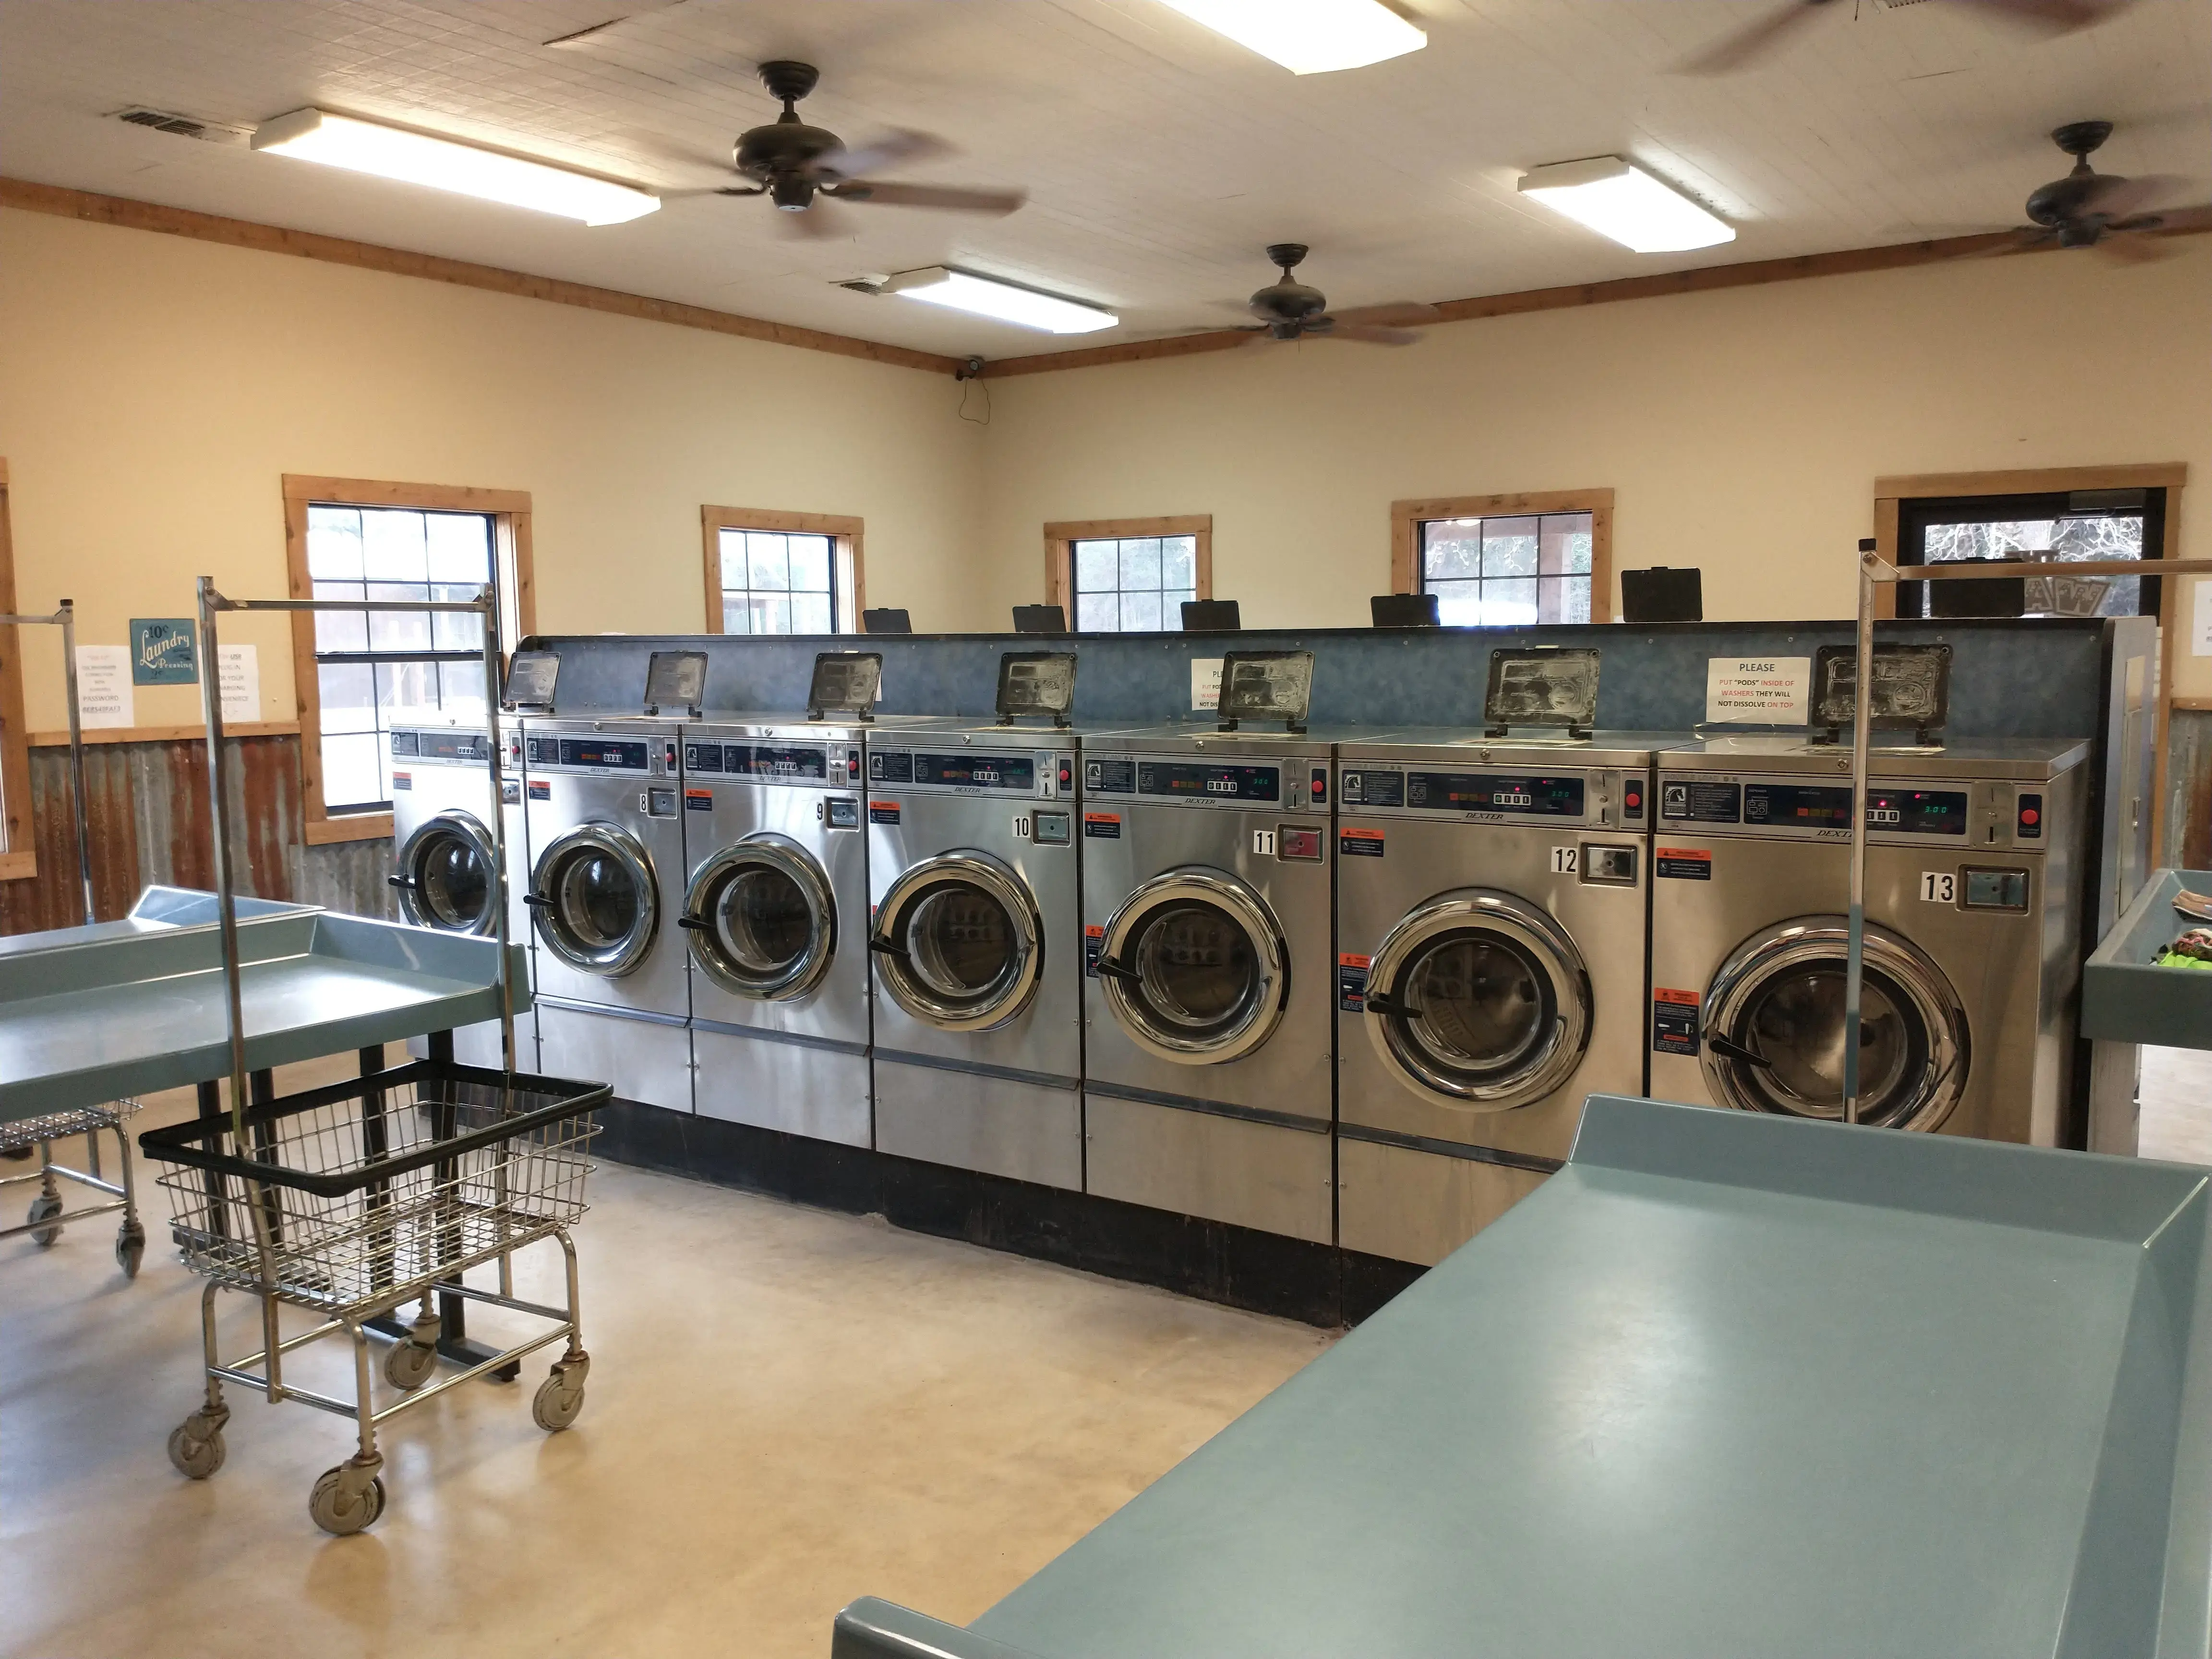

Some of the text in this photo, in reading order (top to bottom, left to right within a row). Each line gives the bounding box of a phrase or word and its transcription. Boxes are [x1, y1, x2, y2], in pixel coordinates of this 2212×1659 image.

[139, 629, 190, 669] Laundry
[1739, 663, 1775, 672] PLEASE
[641, 795, 646, 811] 8
[817, 803, 823, 820] 9
[1015, 817, 1029, 836] 10
[1257, 832, 1273, 854] 11
[1555, 849, 1576, 872] 12
[1926, 874, 1953, 901] 13
